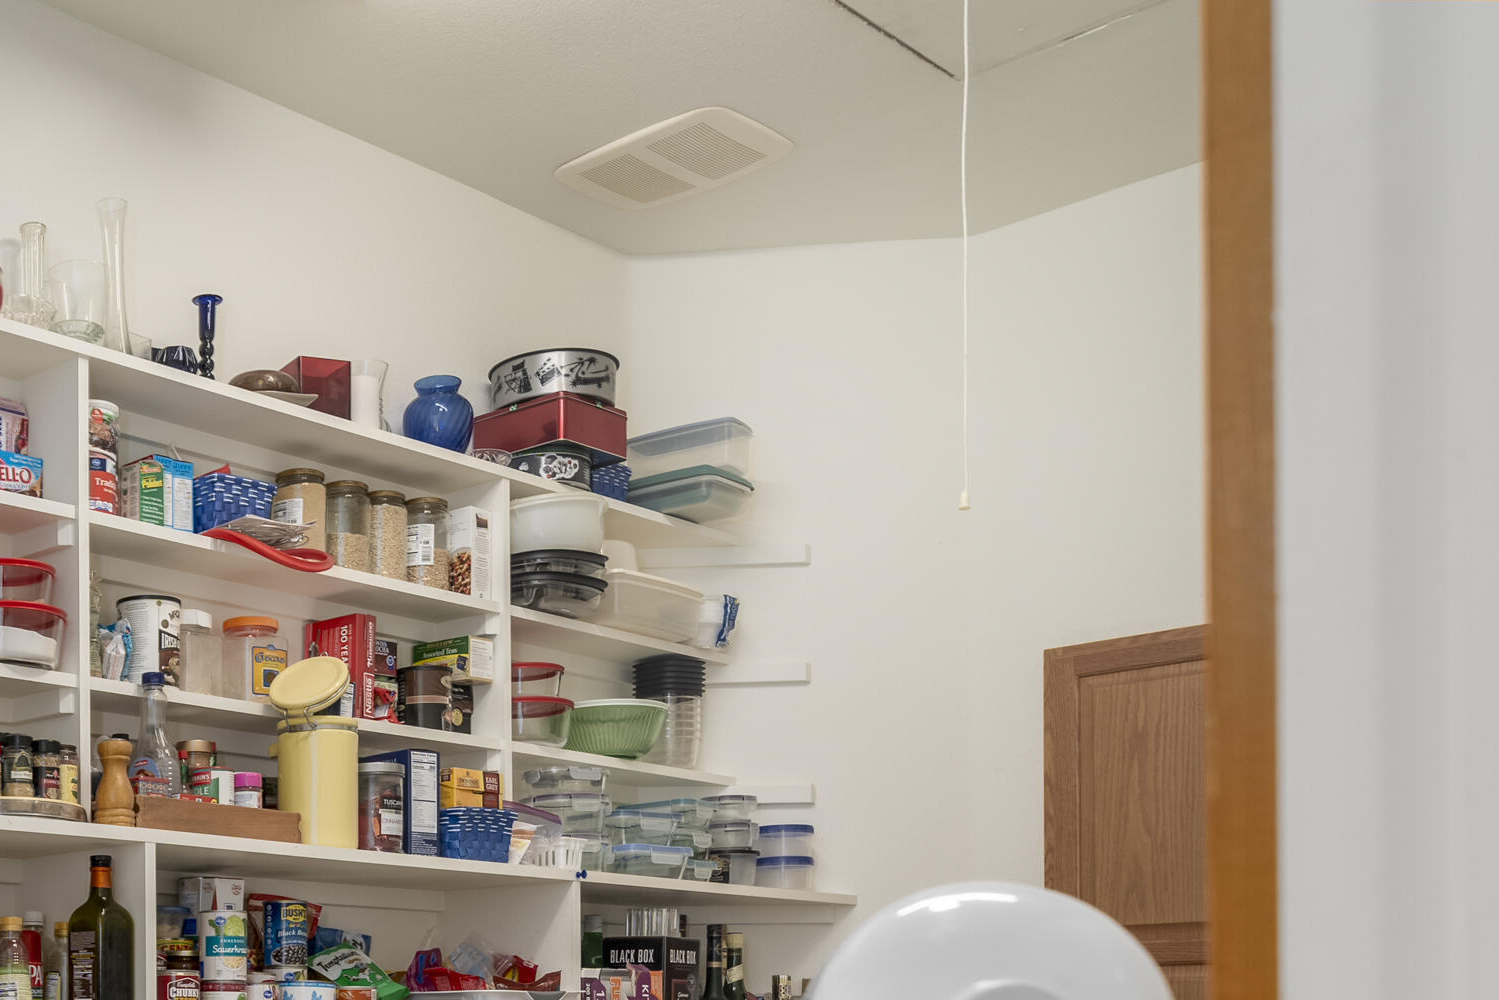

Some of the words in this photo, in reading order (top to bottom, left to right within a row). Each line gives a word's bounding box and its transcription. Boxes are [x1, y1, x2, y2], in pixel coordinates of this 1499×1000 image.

[610, 949, 635, 964] BLACK
[637, 949, 655, 963] BOX
[669, 949, 685, 964] BLACK
[686, 950, 697, 965] BOX
[28, 964, 43, 985] PA
